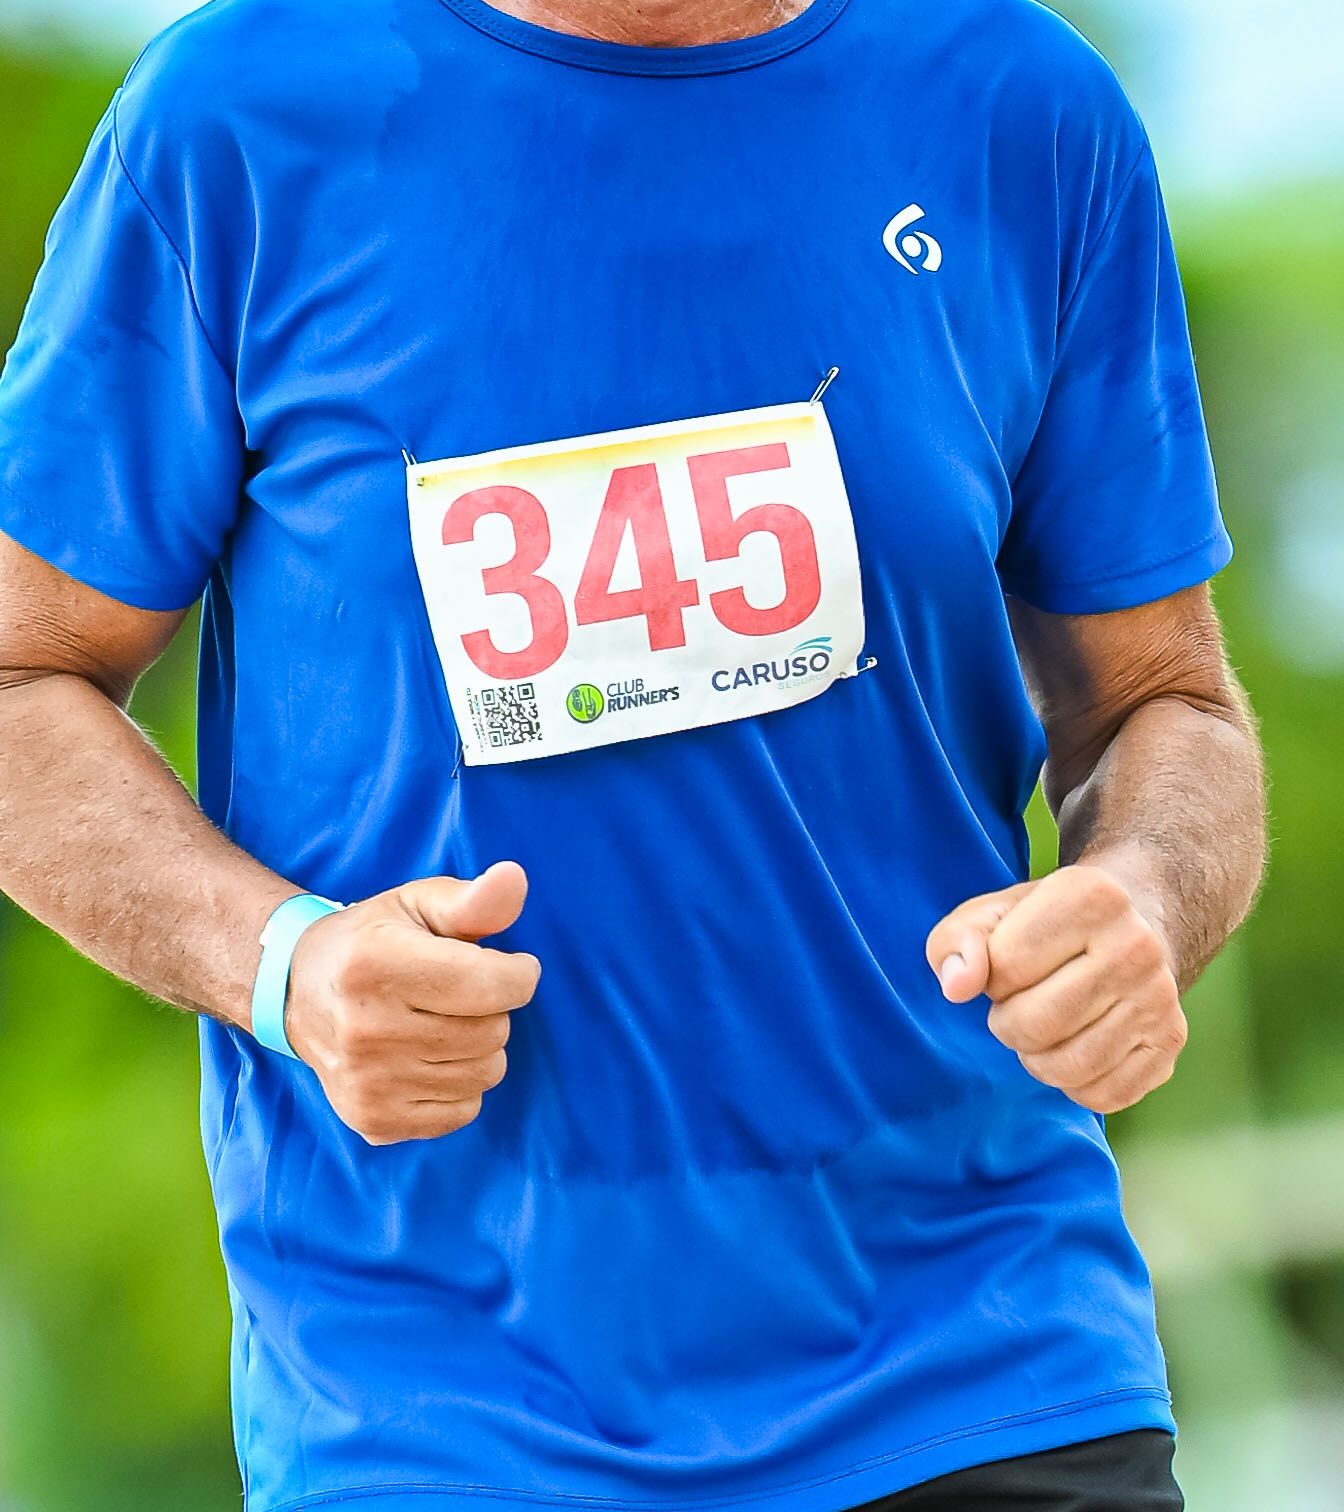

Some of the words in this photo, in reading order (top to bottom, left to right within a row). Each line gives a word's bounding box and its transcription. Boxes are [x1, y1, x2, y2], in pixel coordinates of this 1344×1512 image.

[441, 442, 822, 680] 345
[607, 678, 644, 697] CLUB
[711, 652, 830, 692] CARUSO
[607, 686, 680, 713] RUNNER'S
